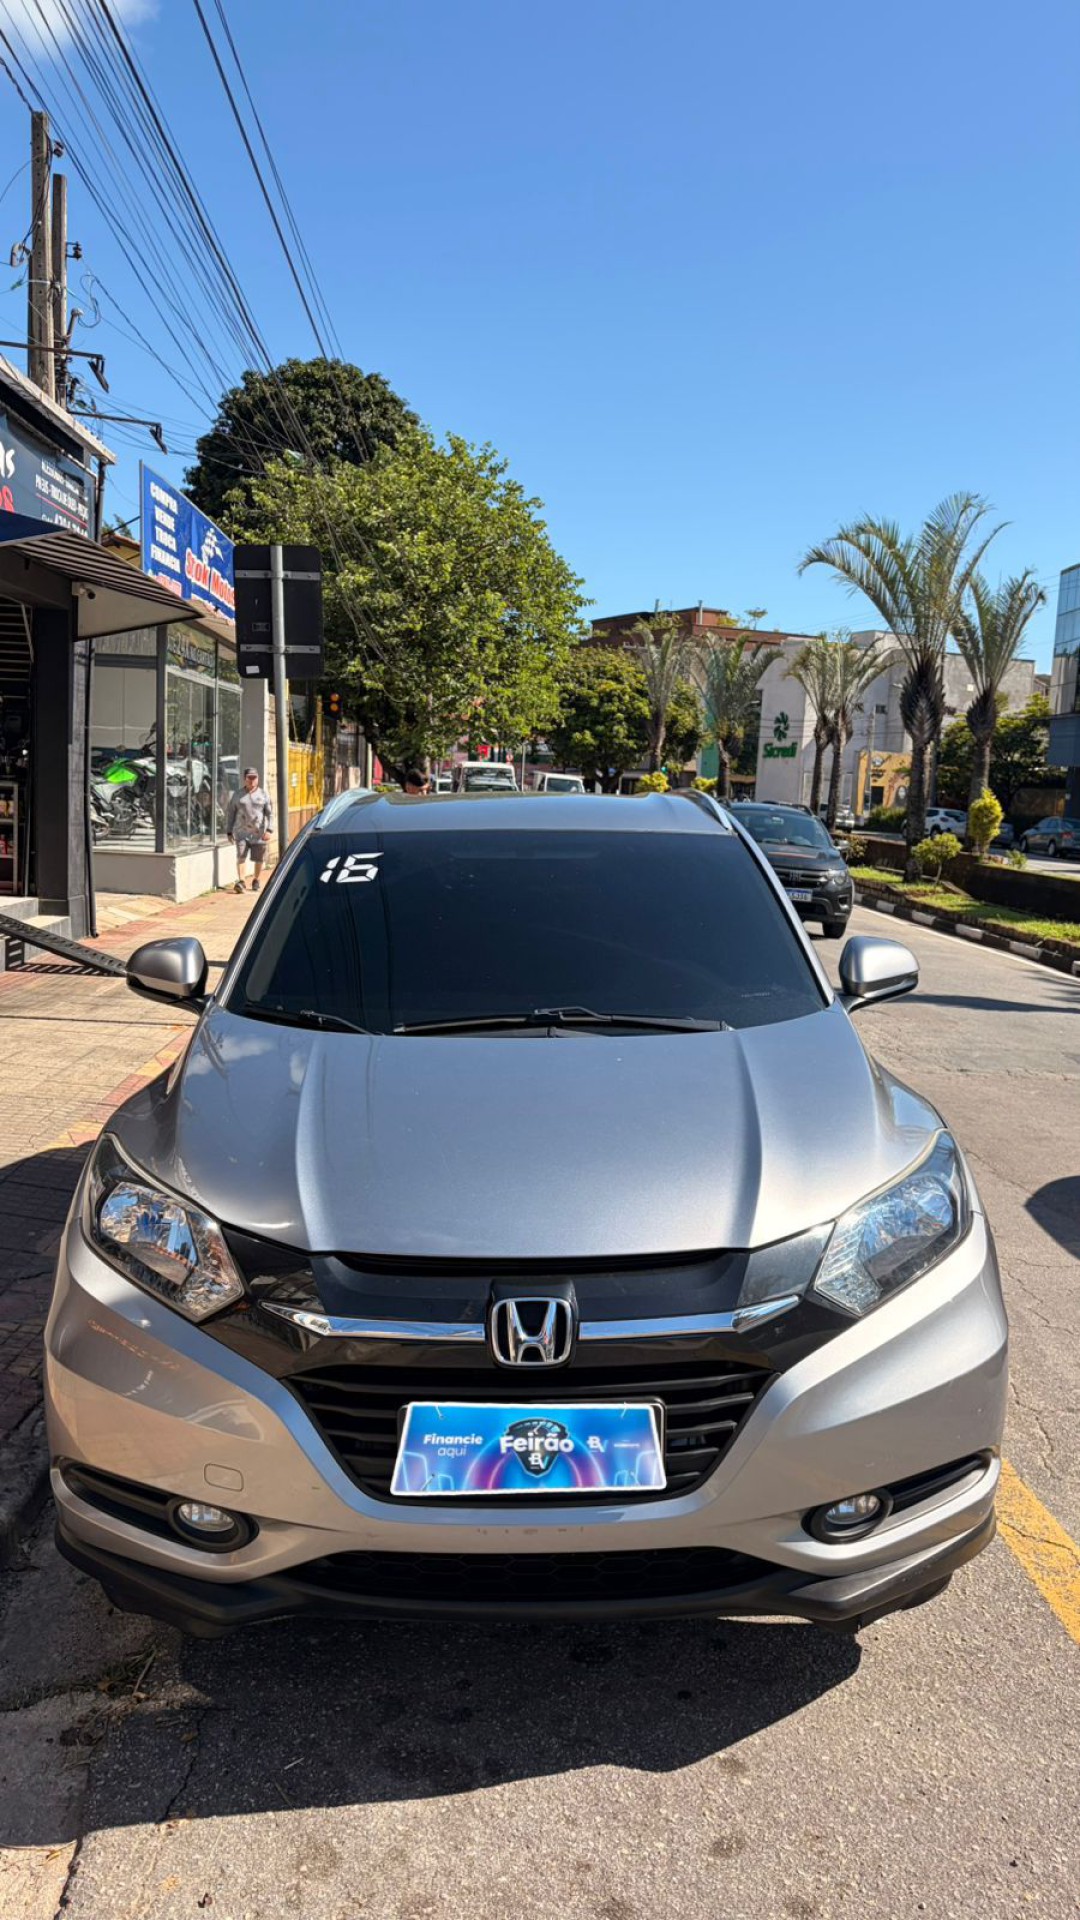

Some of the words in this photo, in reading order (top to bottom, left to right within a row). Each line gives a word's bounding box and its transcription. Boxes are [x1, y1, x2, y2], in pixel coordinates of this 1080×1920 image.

[150, 481, 178, 515] COMPRA
[154, 505, 176, 532] VENDE
[154, 525, 177, 552] TROCA
[319, 851, 385, 883] 16
[423, 1433, 484, 1446] Financie
[437, 1445, 468, 1459] aqui
[499, 1432, 575, 1454] Feirão
